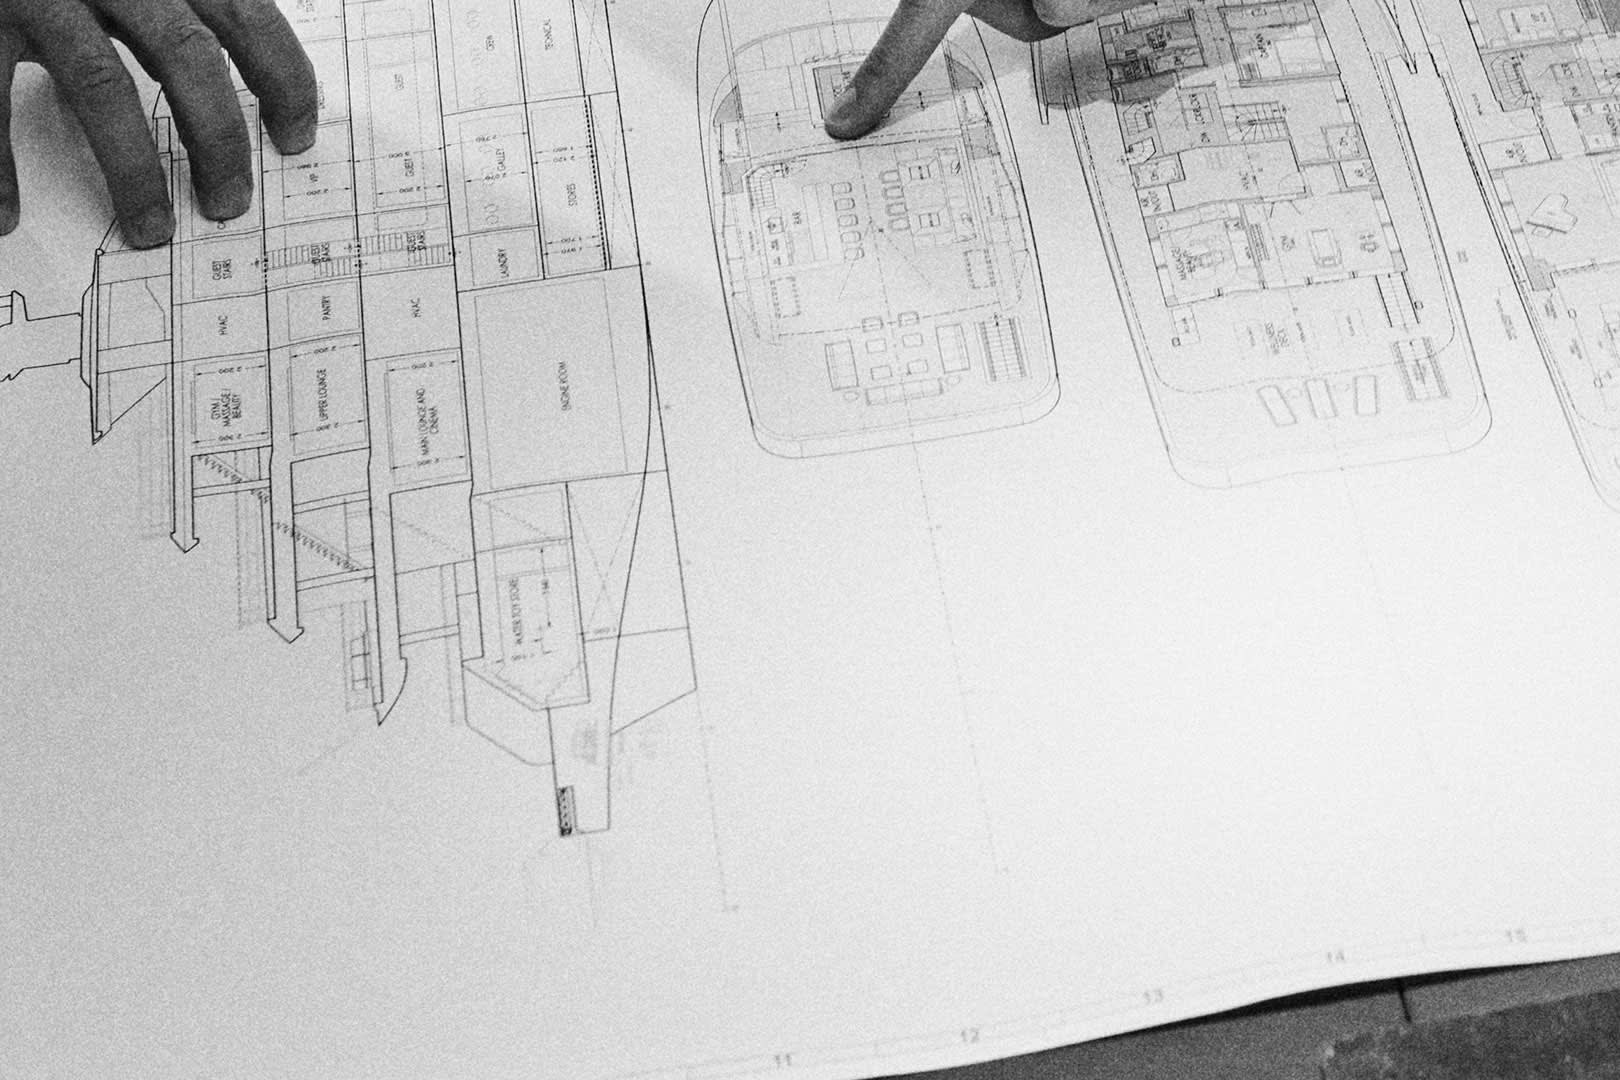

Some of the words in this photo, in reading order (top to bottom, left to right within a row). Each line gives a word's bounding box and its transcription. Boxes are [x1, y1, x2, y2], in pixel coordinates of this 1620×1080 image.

[495, 148, 506, 171] GALLEY
[566, 183, 577, 206] STORES
[212, 259, 221, 279] GUEST
[222, 258, 231, 277] STAIRS
[497, 247, 509, 277] LAUNDRY
[321, 295, 330, 320] PANTRY
[218, 315, 228, 335] HVAC
[316, 368, 328, 398] LOUNGE
[556, 361, 568, 383] ROOM
[232, 393, 242, 418] BEAUTY
[559, 385, 571, 410] ENGINE
[211, 403, 220, 419] GYM
[222, 394, 231, 426] MASSAGE
[318, 400, 329, 420] UPPER
[418, 404, 428, 431] LOUNGE
[429, 406, 439, 434] CINEMA
[1325, 949, 1346, 964] 14
[1143, 988, 1165, 1004] 13
[960, 1027, 981, 1045] 12
[773, 1053, 794, 1069] 11
